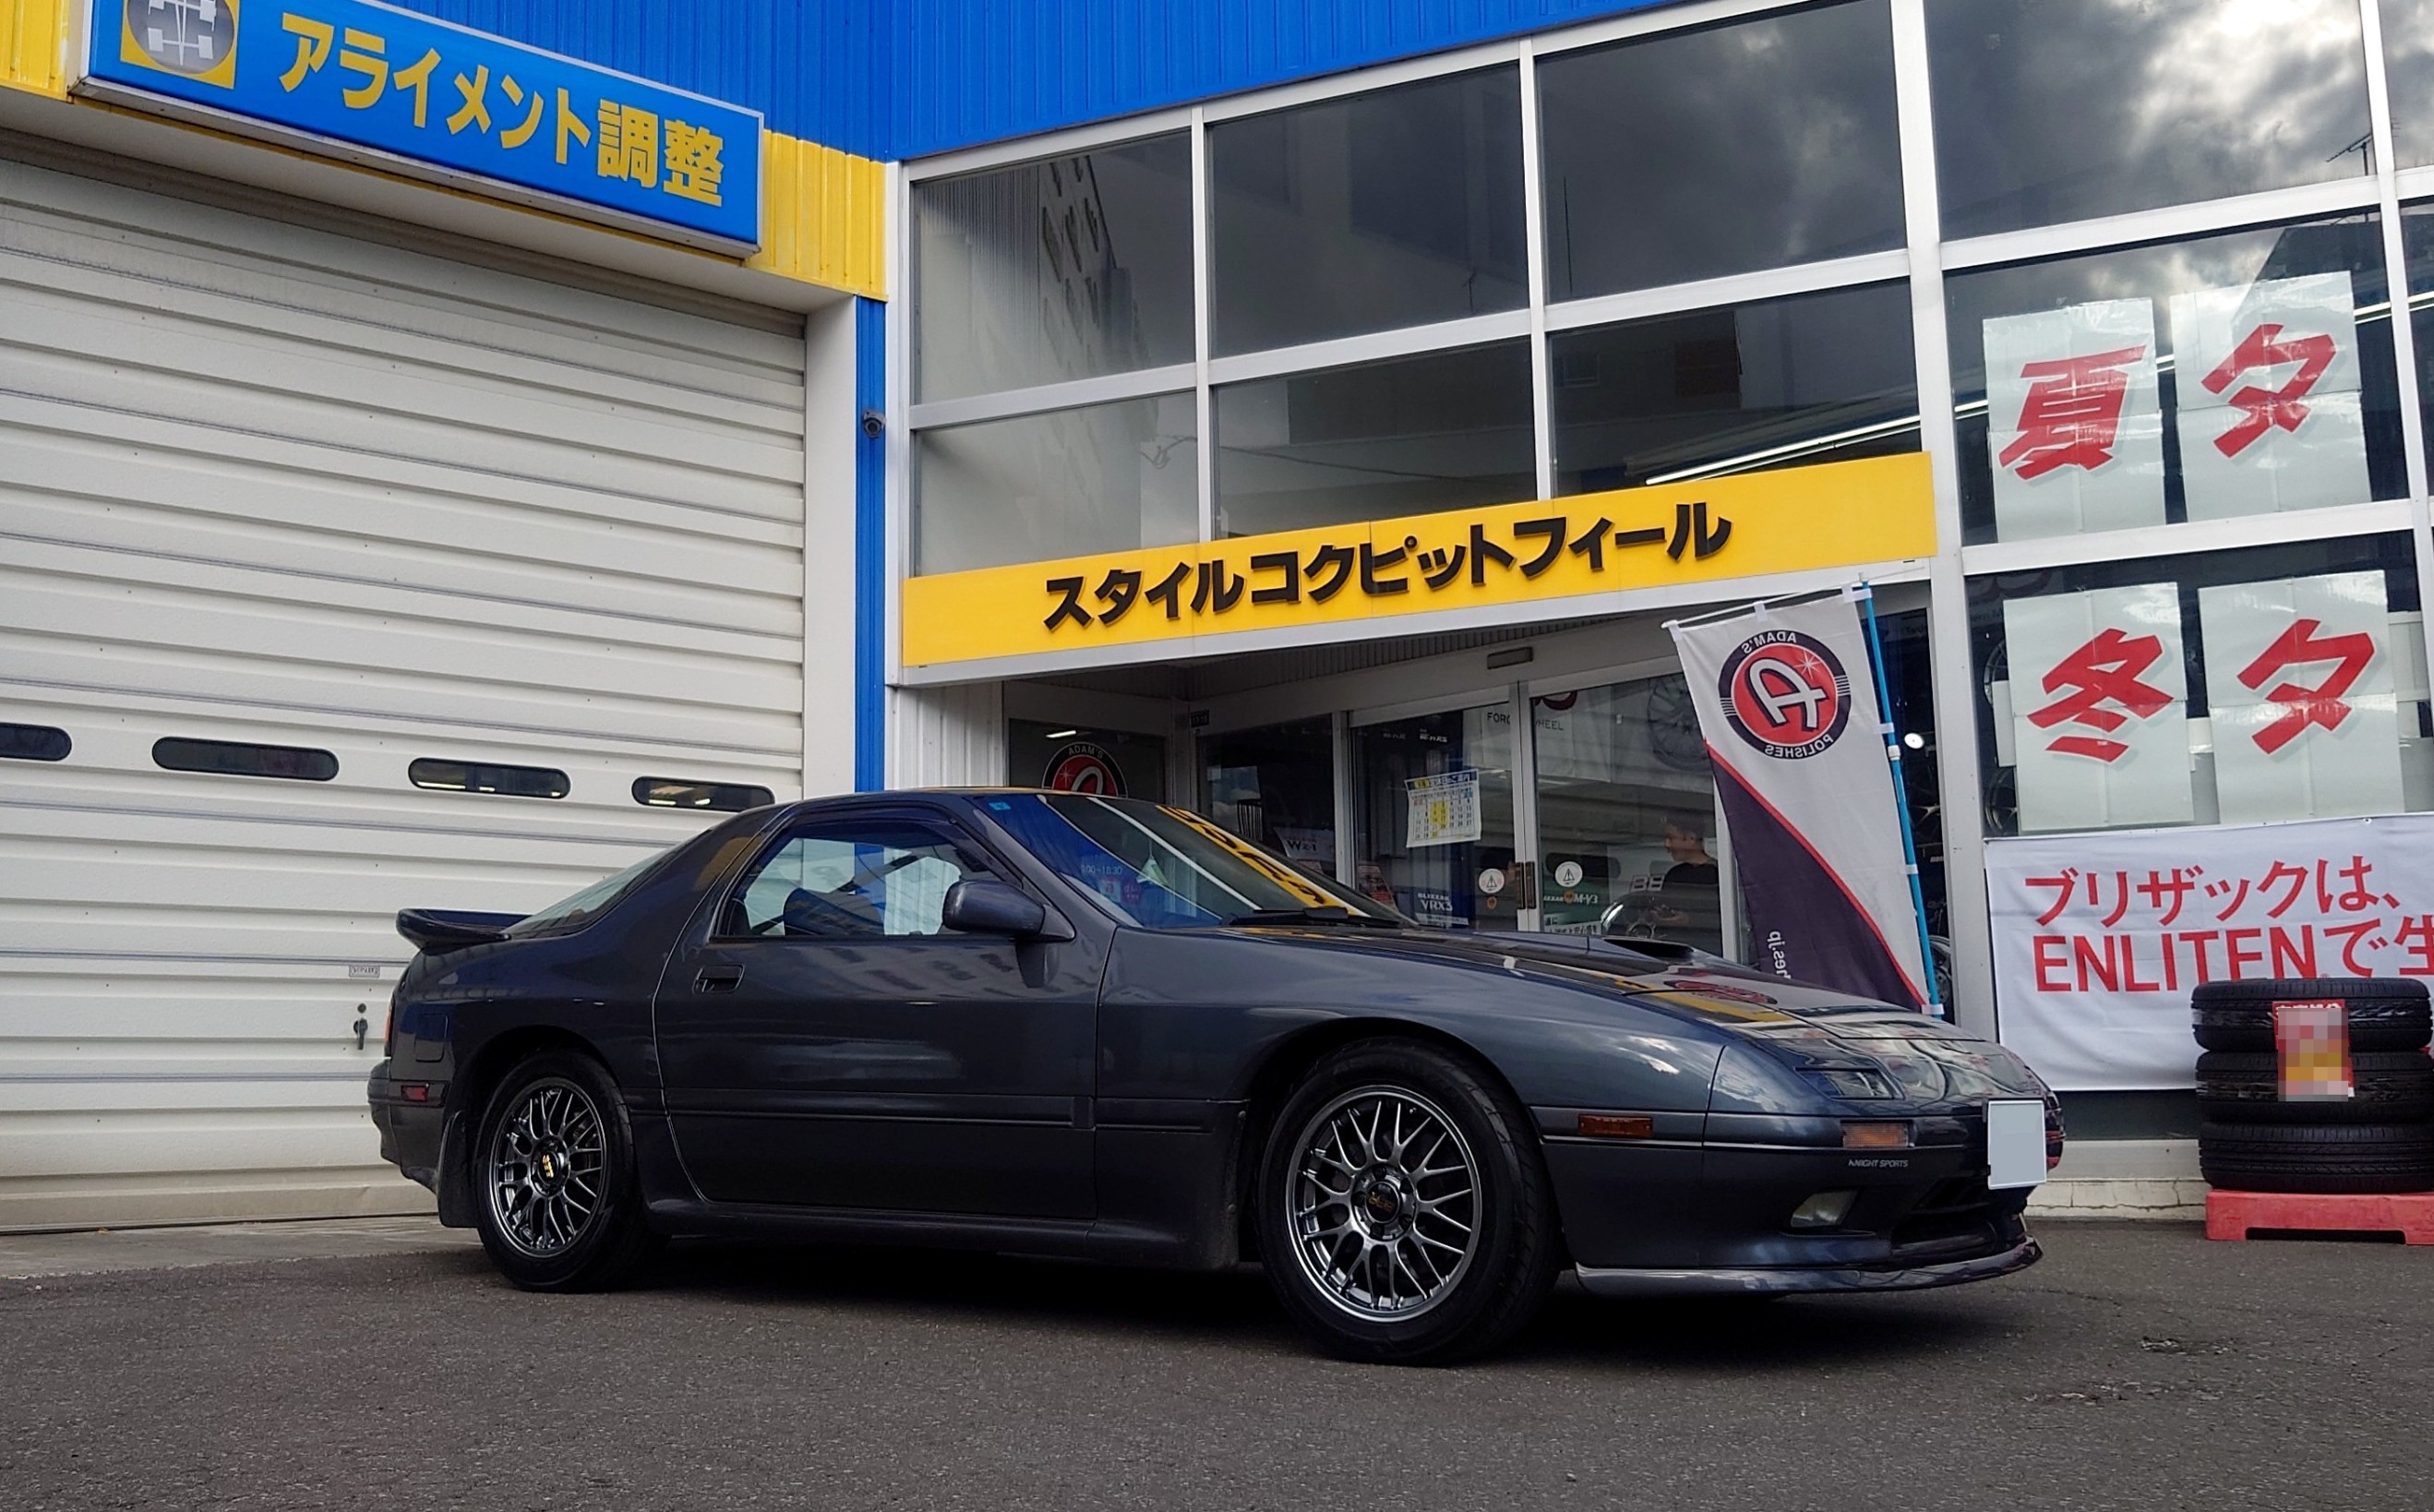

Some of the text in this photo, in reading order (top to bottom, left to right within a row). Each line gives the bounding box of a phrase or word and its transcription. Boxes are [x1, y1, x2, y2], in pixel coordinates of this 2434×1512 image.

[279, 12, 725, 208] アライメント調整
[1044, 501, 1733, 632] スタイルコクピットフィール
[1068, 745, 1104, 759] ADAM'S
[1420, 899, 1454, 912] VRX3
[1879, 1159, 1909, 1168] SPORTS
